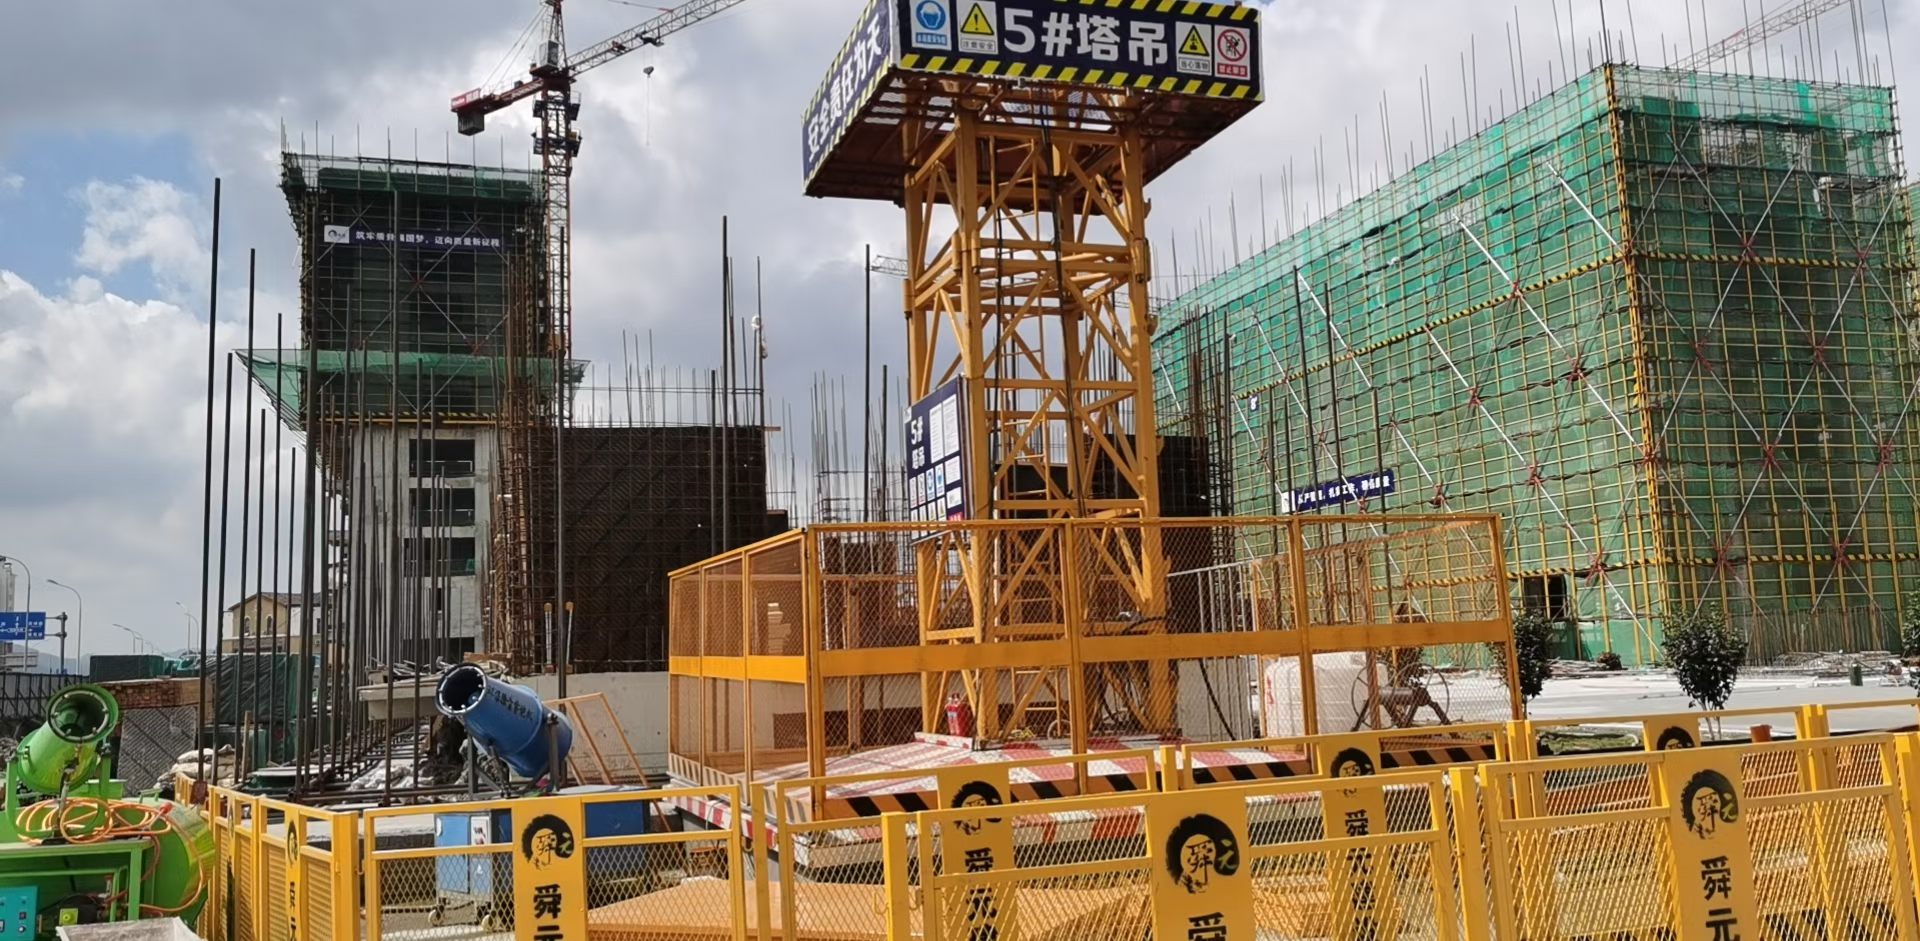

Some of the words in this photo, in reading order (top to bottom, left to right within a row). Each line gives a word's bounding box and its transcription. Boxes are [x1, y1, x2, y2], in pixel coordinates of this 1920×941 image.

[1003, 7, 1168, 66] 5#塔吊
[807, 12, 882, 163] 安全责任为天
[1701, 855, 1741, 941] 舜元
